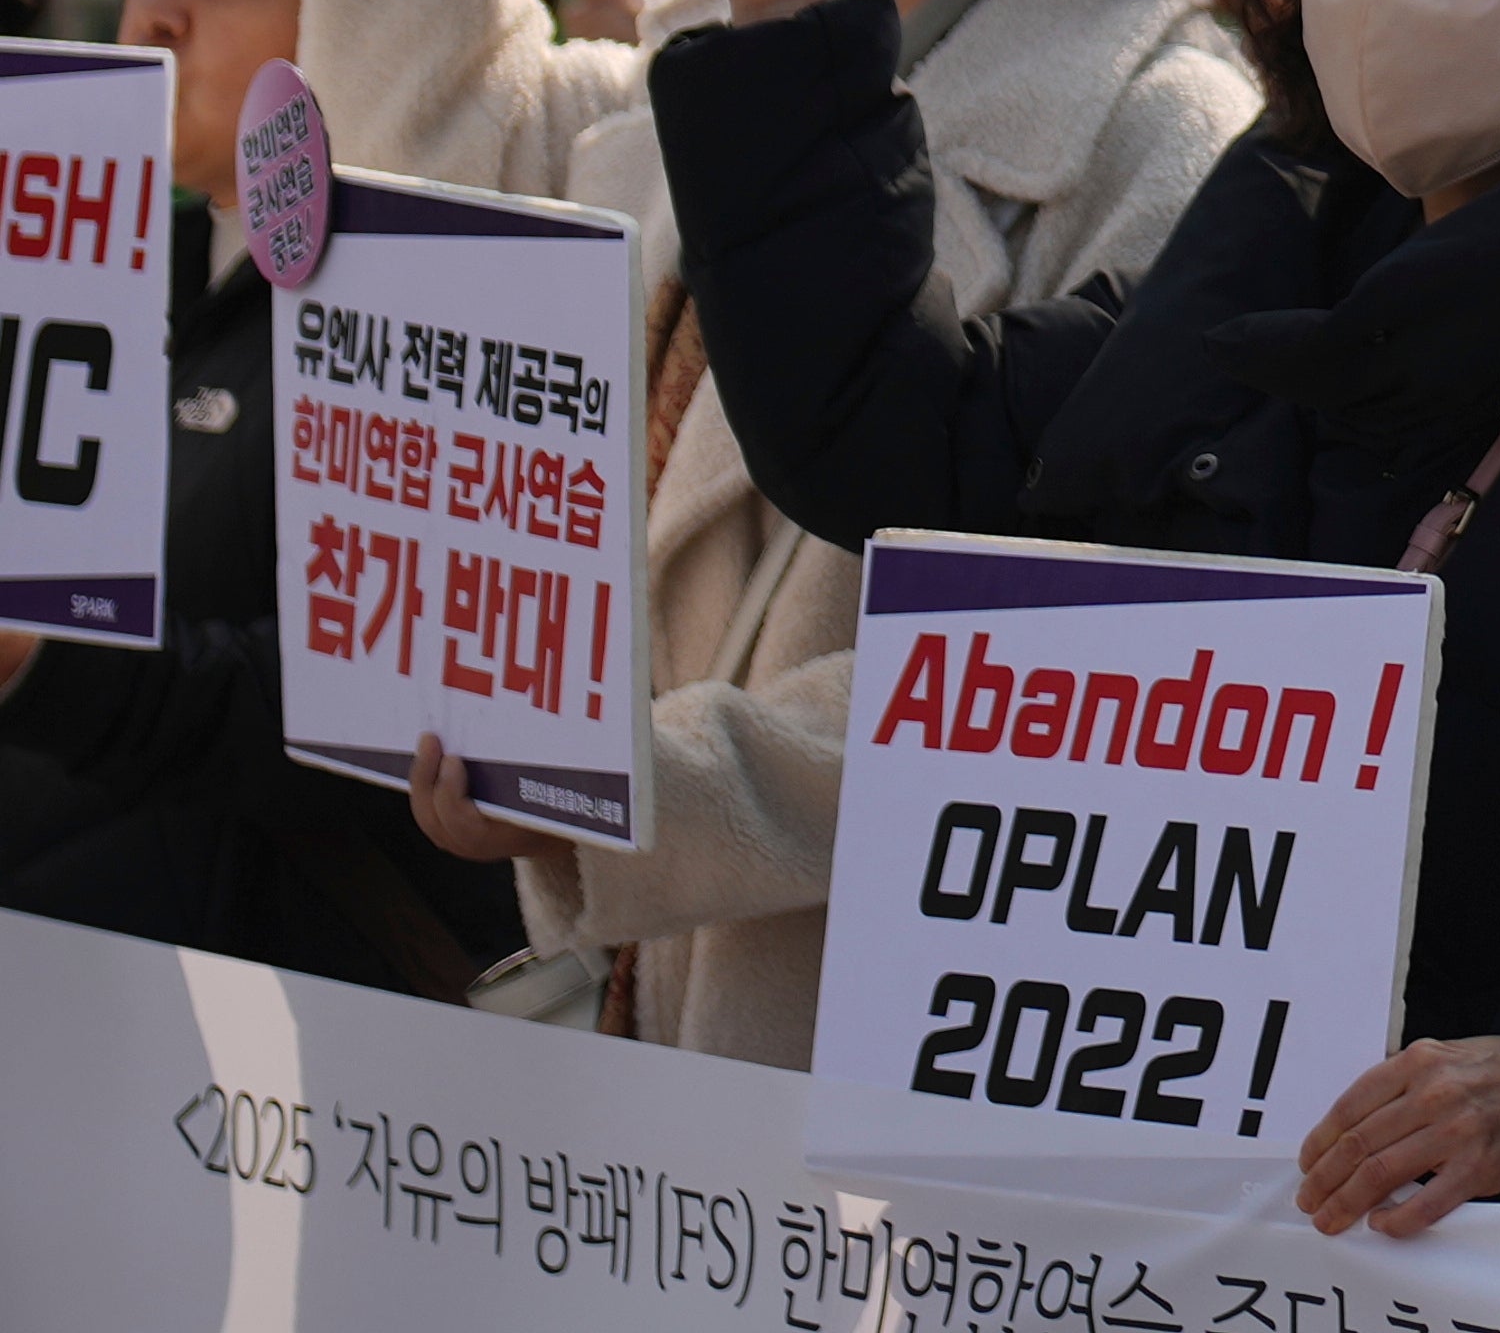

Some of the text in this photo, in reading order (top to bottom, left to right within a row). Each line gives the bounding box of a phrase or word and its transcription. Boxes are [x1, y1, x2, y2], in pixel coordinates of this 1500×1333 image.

[294, 300, 609, 434] 유엔사 전력 제공국의
[292, 394, 606, 549] 한미연합 군사연습
[306, 514, 425, 676] 참가
[919, 800, 1295, 950] OPLAN
